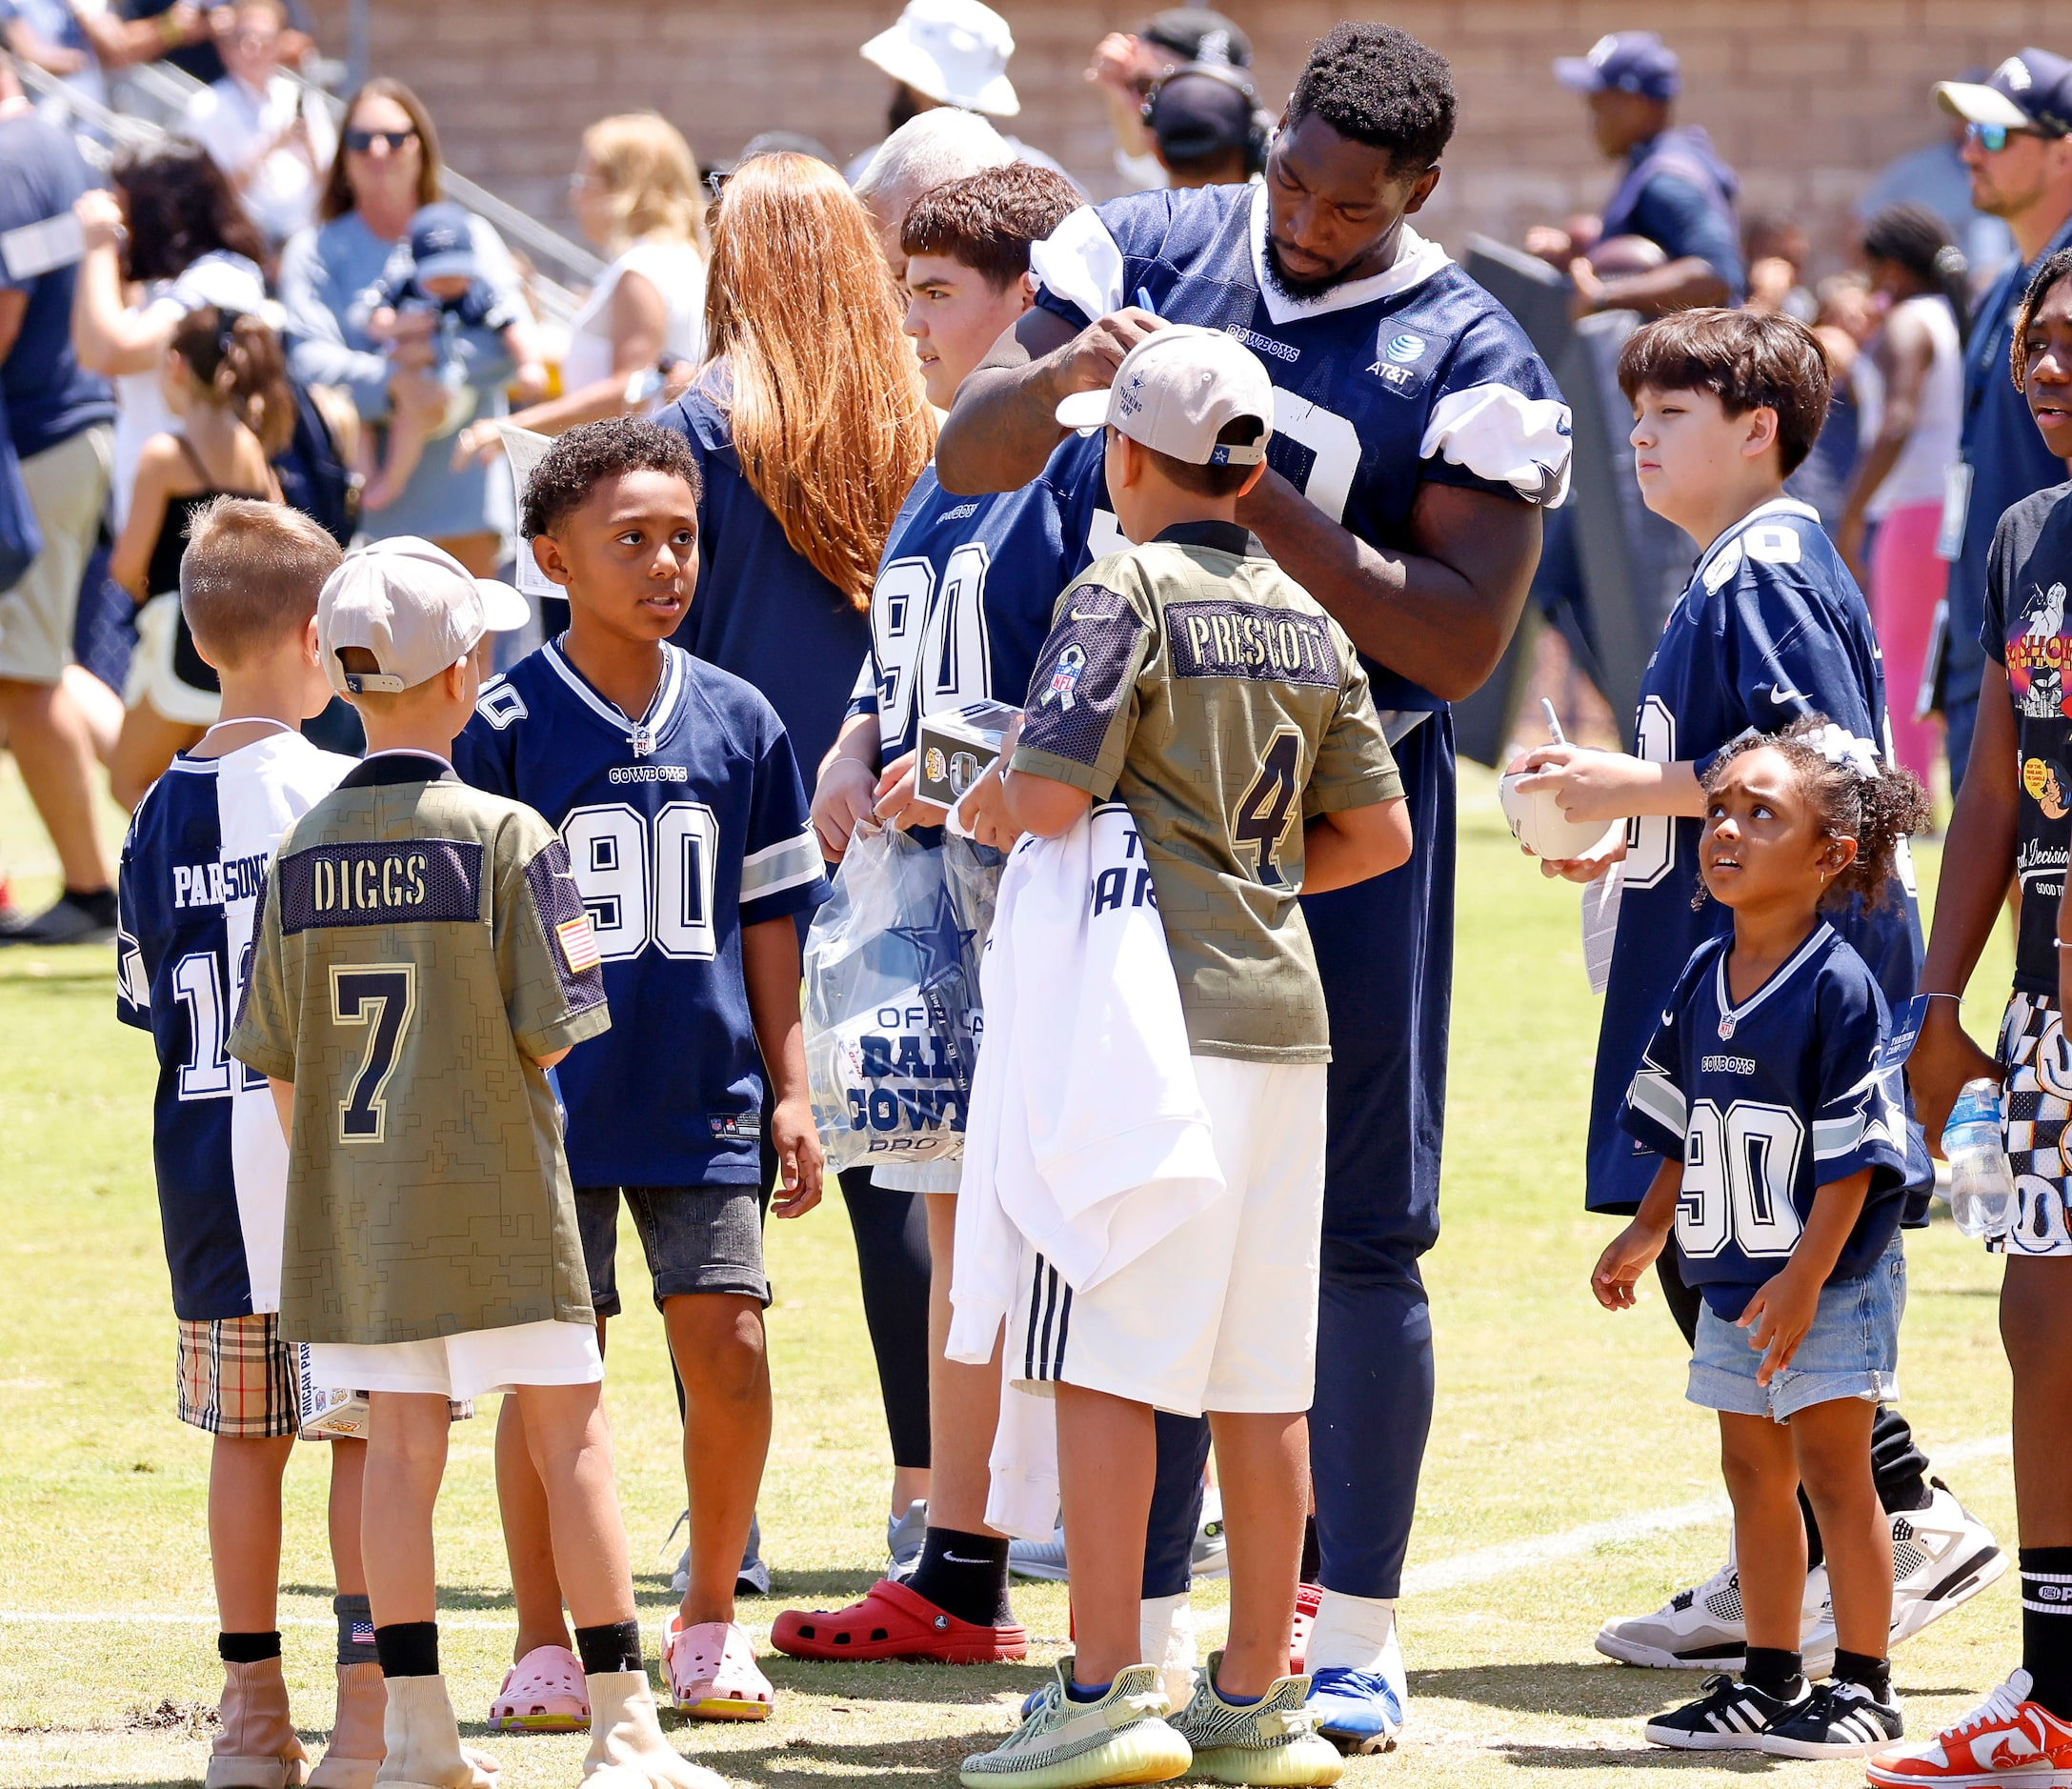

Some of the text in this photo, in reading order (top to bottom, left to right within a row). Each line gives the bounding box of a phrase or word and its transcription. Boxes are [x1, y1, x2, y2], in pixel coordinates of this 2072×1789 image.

[1226, 323, 1300, 362] COWBOYS
[1365, 361, 1414, 385] AT&T
[1119, 386, 1142, 412] TRAINING
[1120, 400, 1133, 416] CAMP
[870, 541, 992, 748] 90
[1188, 613, 1330, 674] PRESCOTT
[1053, 674, 1072, 690] NFL
[610, 766, 688, 784] COWBOYS
[1233, 724, 1306, 892] 4
[1123, 831, 1146, 859] T
[312, 851, 428, 912] DIGGS
[556, 800, 720, 963] 90
[2036, 882, 2056, 896] GOOD
[329, 962, 417, 1144] 7
[1891, 1031, 1916, 1046] TRAINING
[1701, 1055, 1756, 1075] COWBOYS
[1675, 1098, 1805, 1258] 90
[301, 1371, 312, 1417] MICAH
